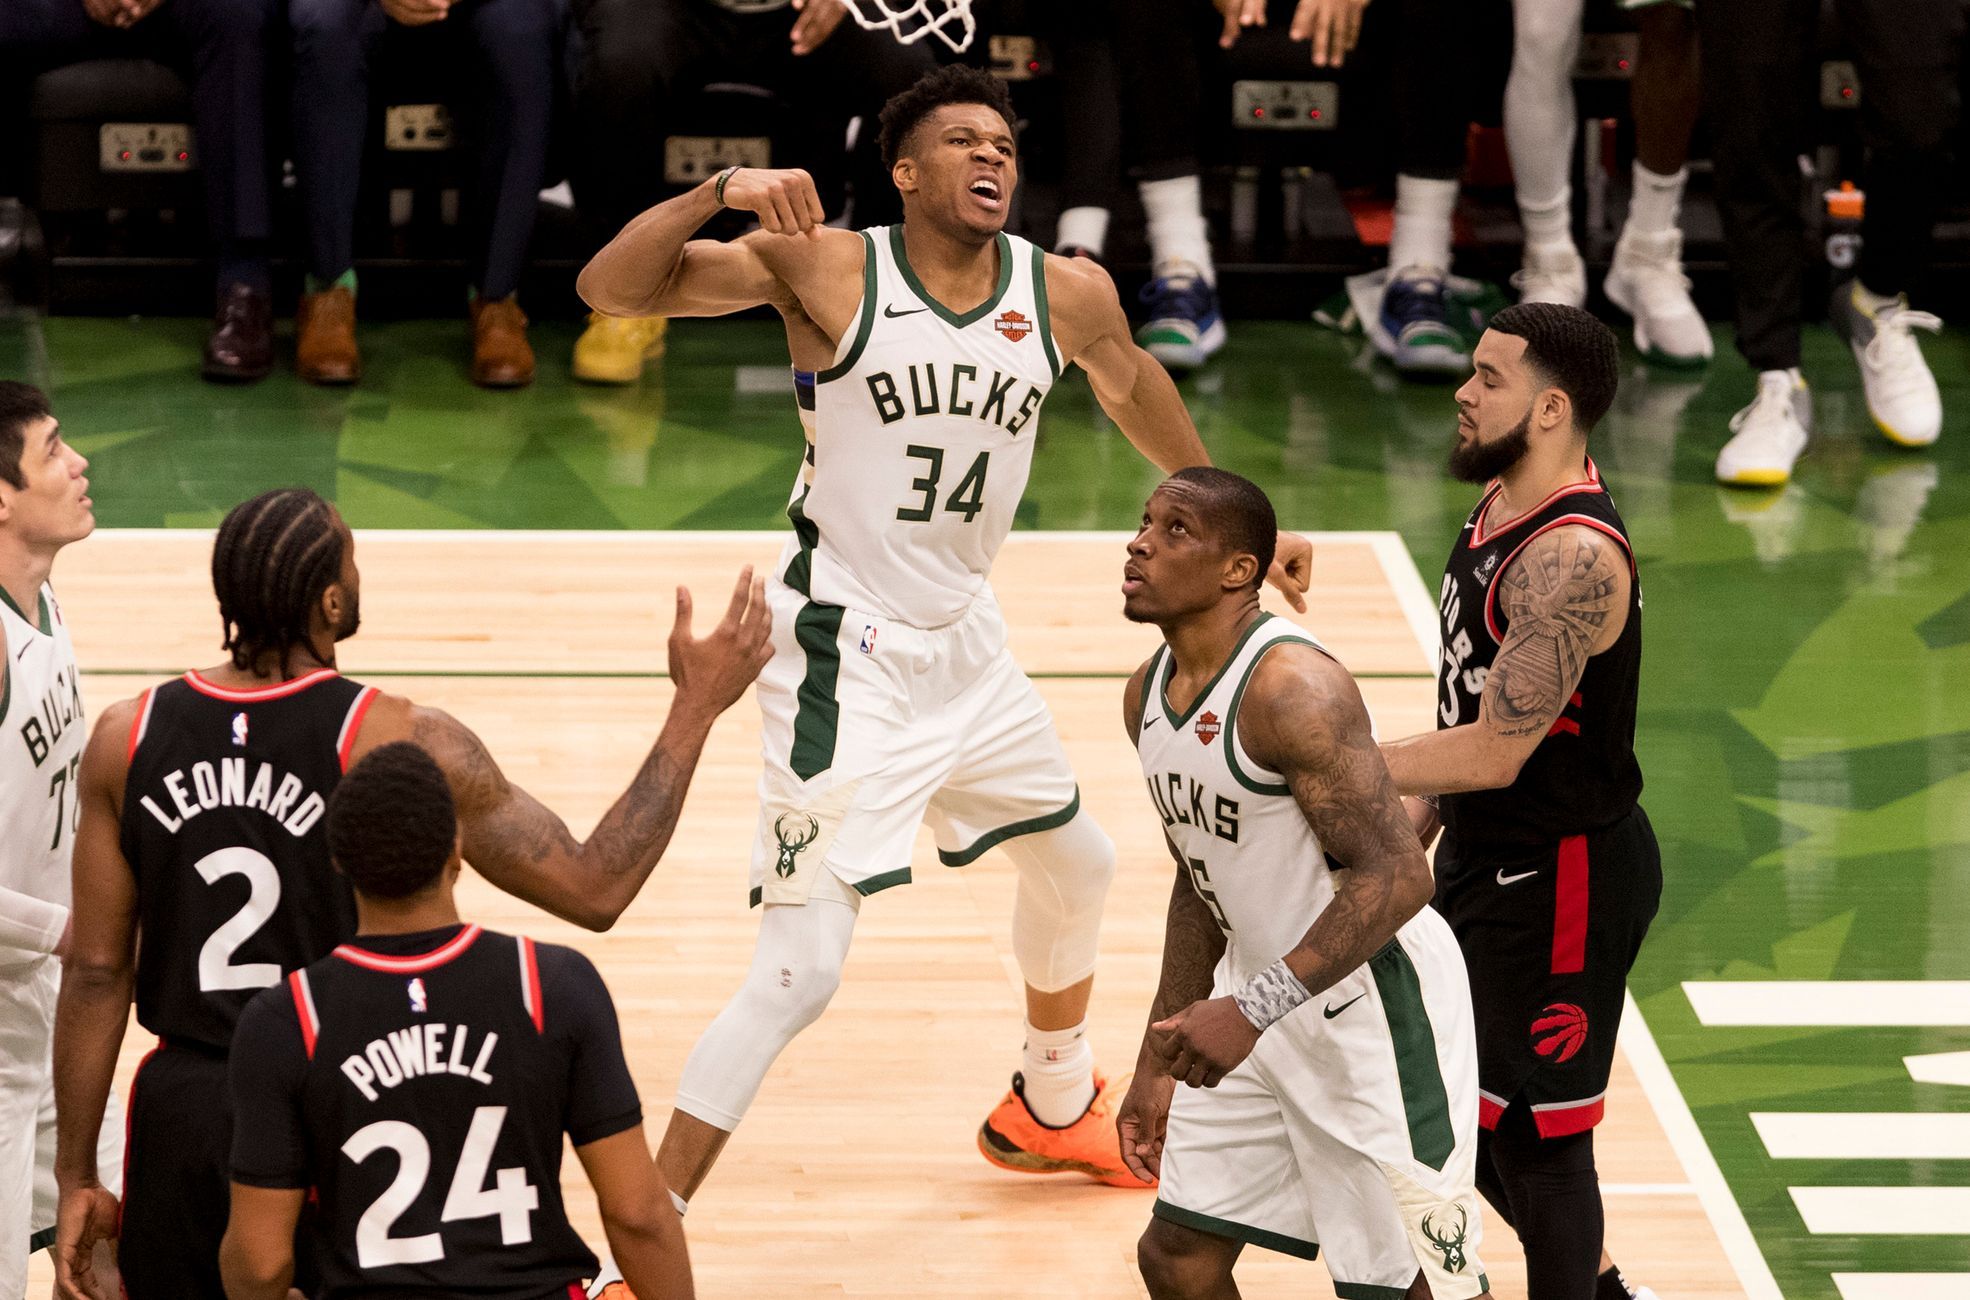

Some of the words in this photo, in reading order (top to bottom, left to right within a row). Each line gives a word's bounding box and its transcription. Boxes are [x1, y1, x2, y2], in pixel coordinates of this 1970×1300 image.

[865, 363, 1043, 437] BUCKS
[896, 444, 991, 523] 34
[140, 757, 326, 837] LEONARD
[194, 846, 282, 992] 2
[1187, 856, 1233, 931] 6
[340, 1023, 498, 1101] POWELL
[340, 1105, 539, 1269] 24
